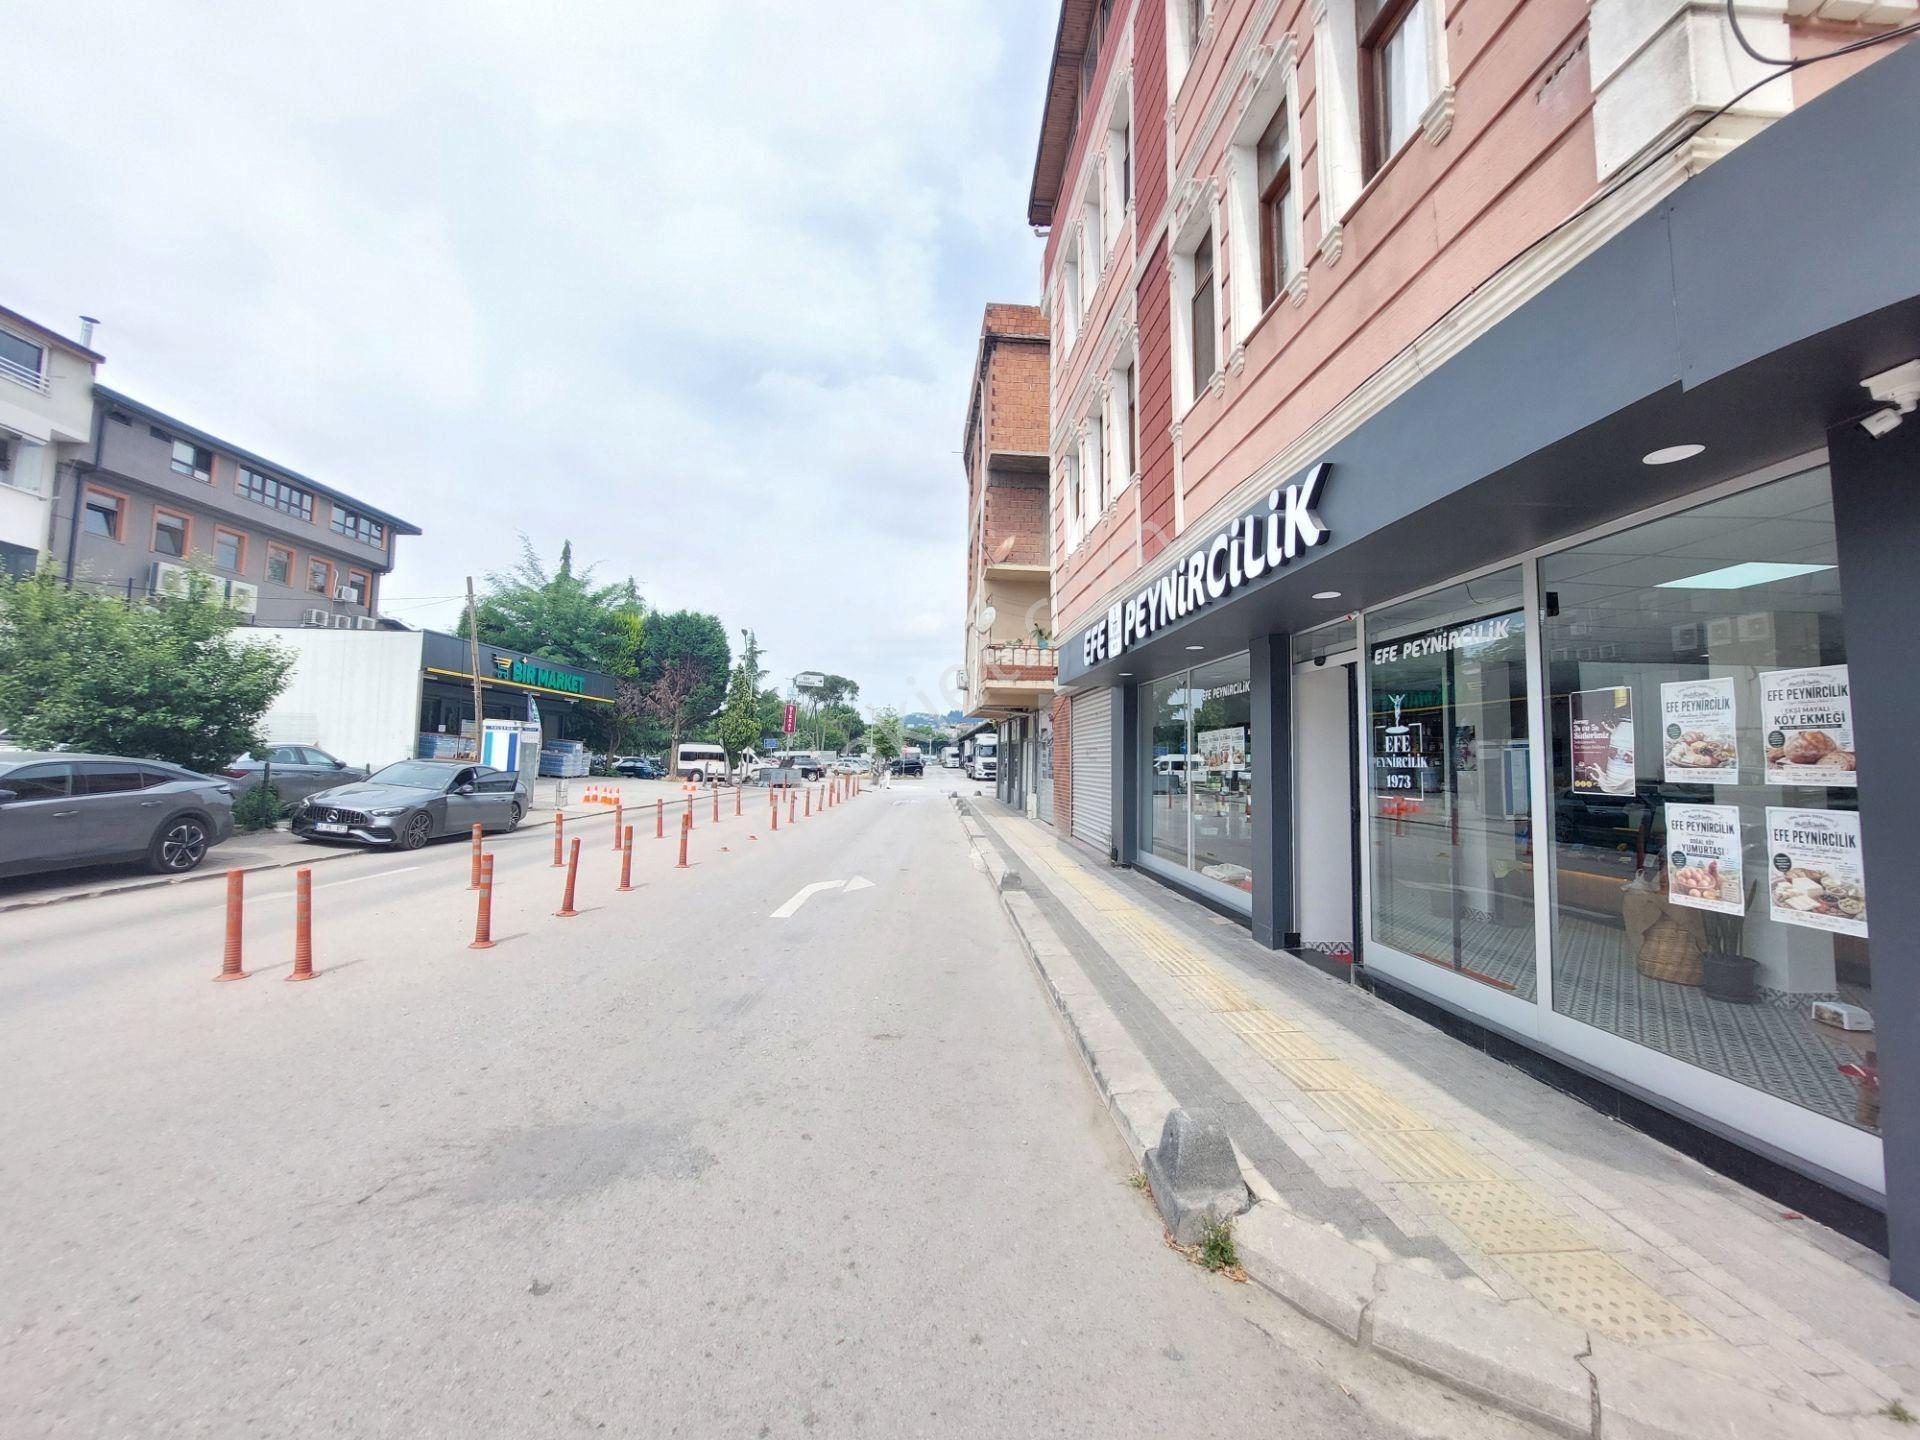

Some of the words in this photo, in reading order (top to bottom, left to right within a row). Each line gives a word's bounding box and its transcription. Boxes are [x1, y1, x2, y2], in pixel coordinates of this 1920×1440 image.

[1083, 617, 1107, 667] EFE
[1374, 645, 1398, 665] EFE
[538, 668, 585, 693] MARKET
[1203, 689, 1211, 701] EFE
[1767, 689, 1784, 702] EFE
[1666, 701, 1679, 713] EFE
[1774, 713, 1796, 725] KÖY
[1385, 735, 1411, 753] EFE
[1386, 774, 1412, 789] 1973
[1671, 820, 1684, 831] EFE
[1774, 829, 1789, 843] EFE
